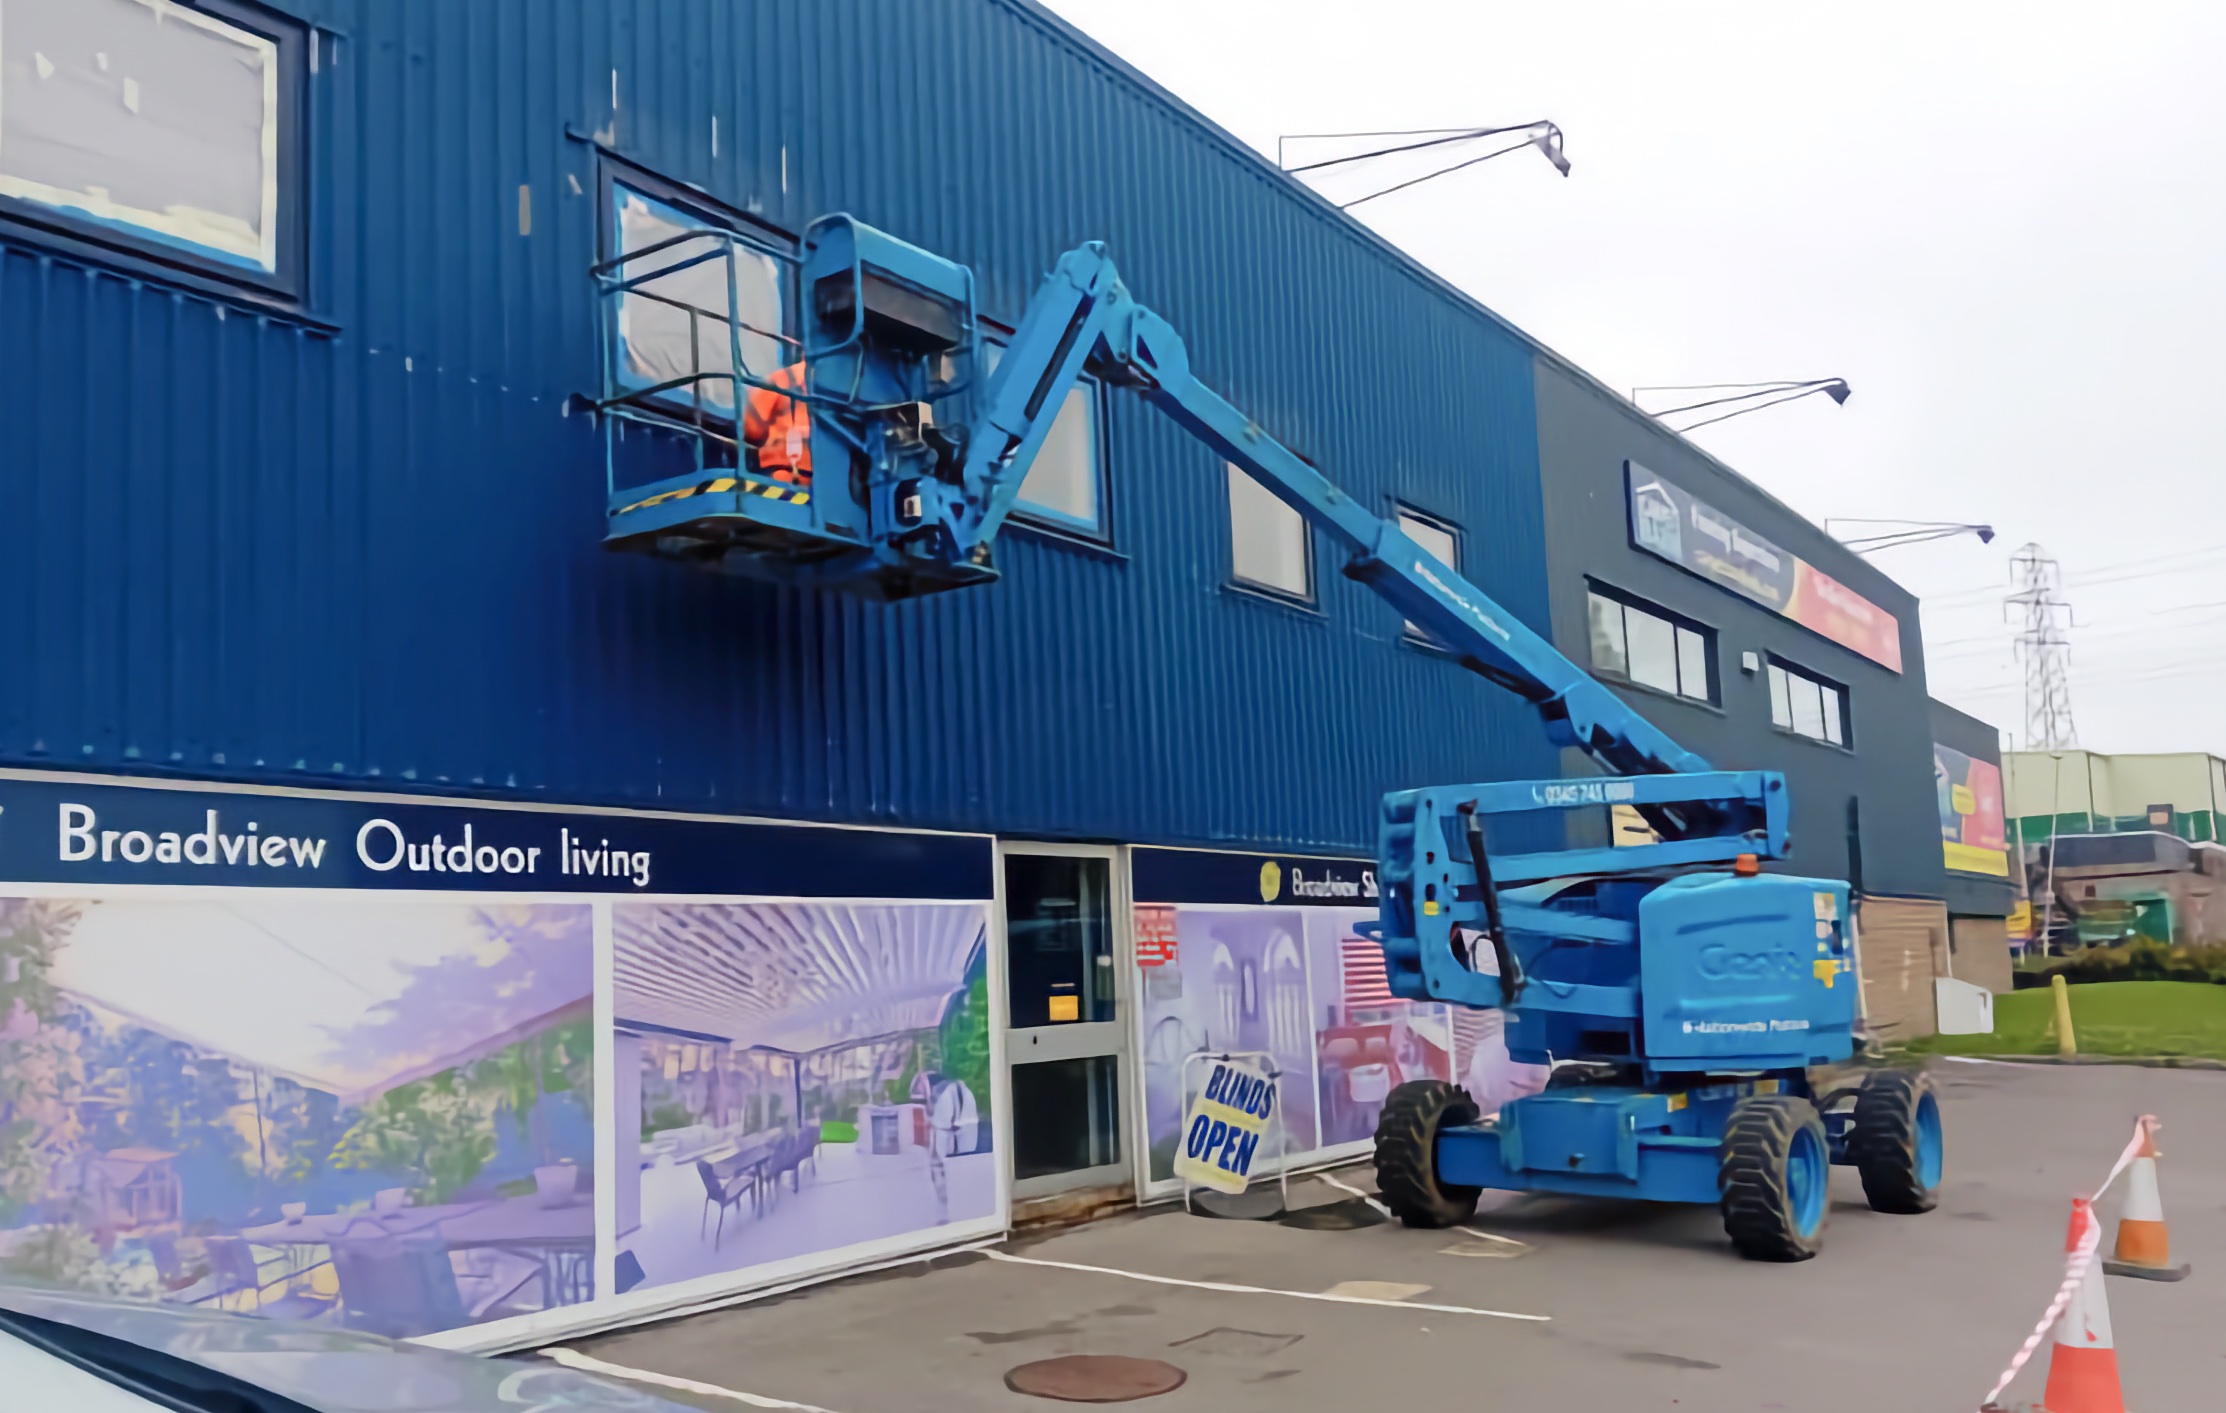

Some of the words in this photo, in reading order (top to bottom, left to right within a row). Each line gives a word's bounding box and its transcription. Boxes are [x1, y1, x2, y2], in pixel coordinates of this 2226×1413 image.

[59, 803, 326, 869] Broadview
[356, 818, 541, 874] Outdoor
[561, 827, 651, 887] living
[1205, 1064, 1276, 1120] BLINDS
[1187, 1114, 1259, 1177] OPEN
